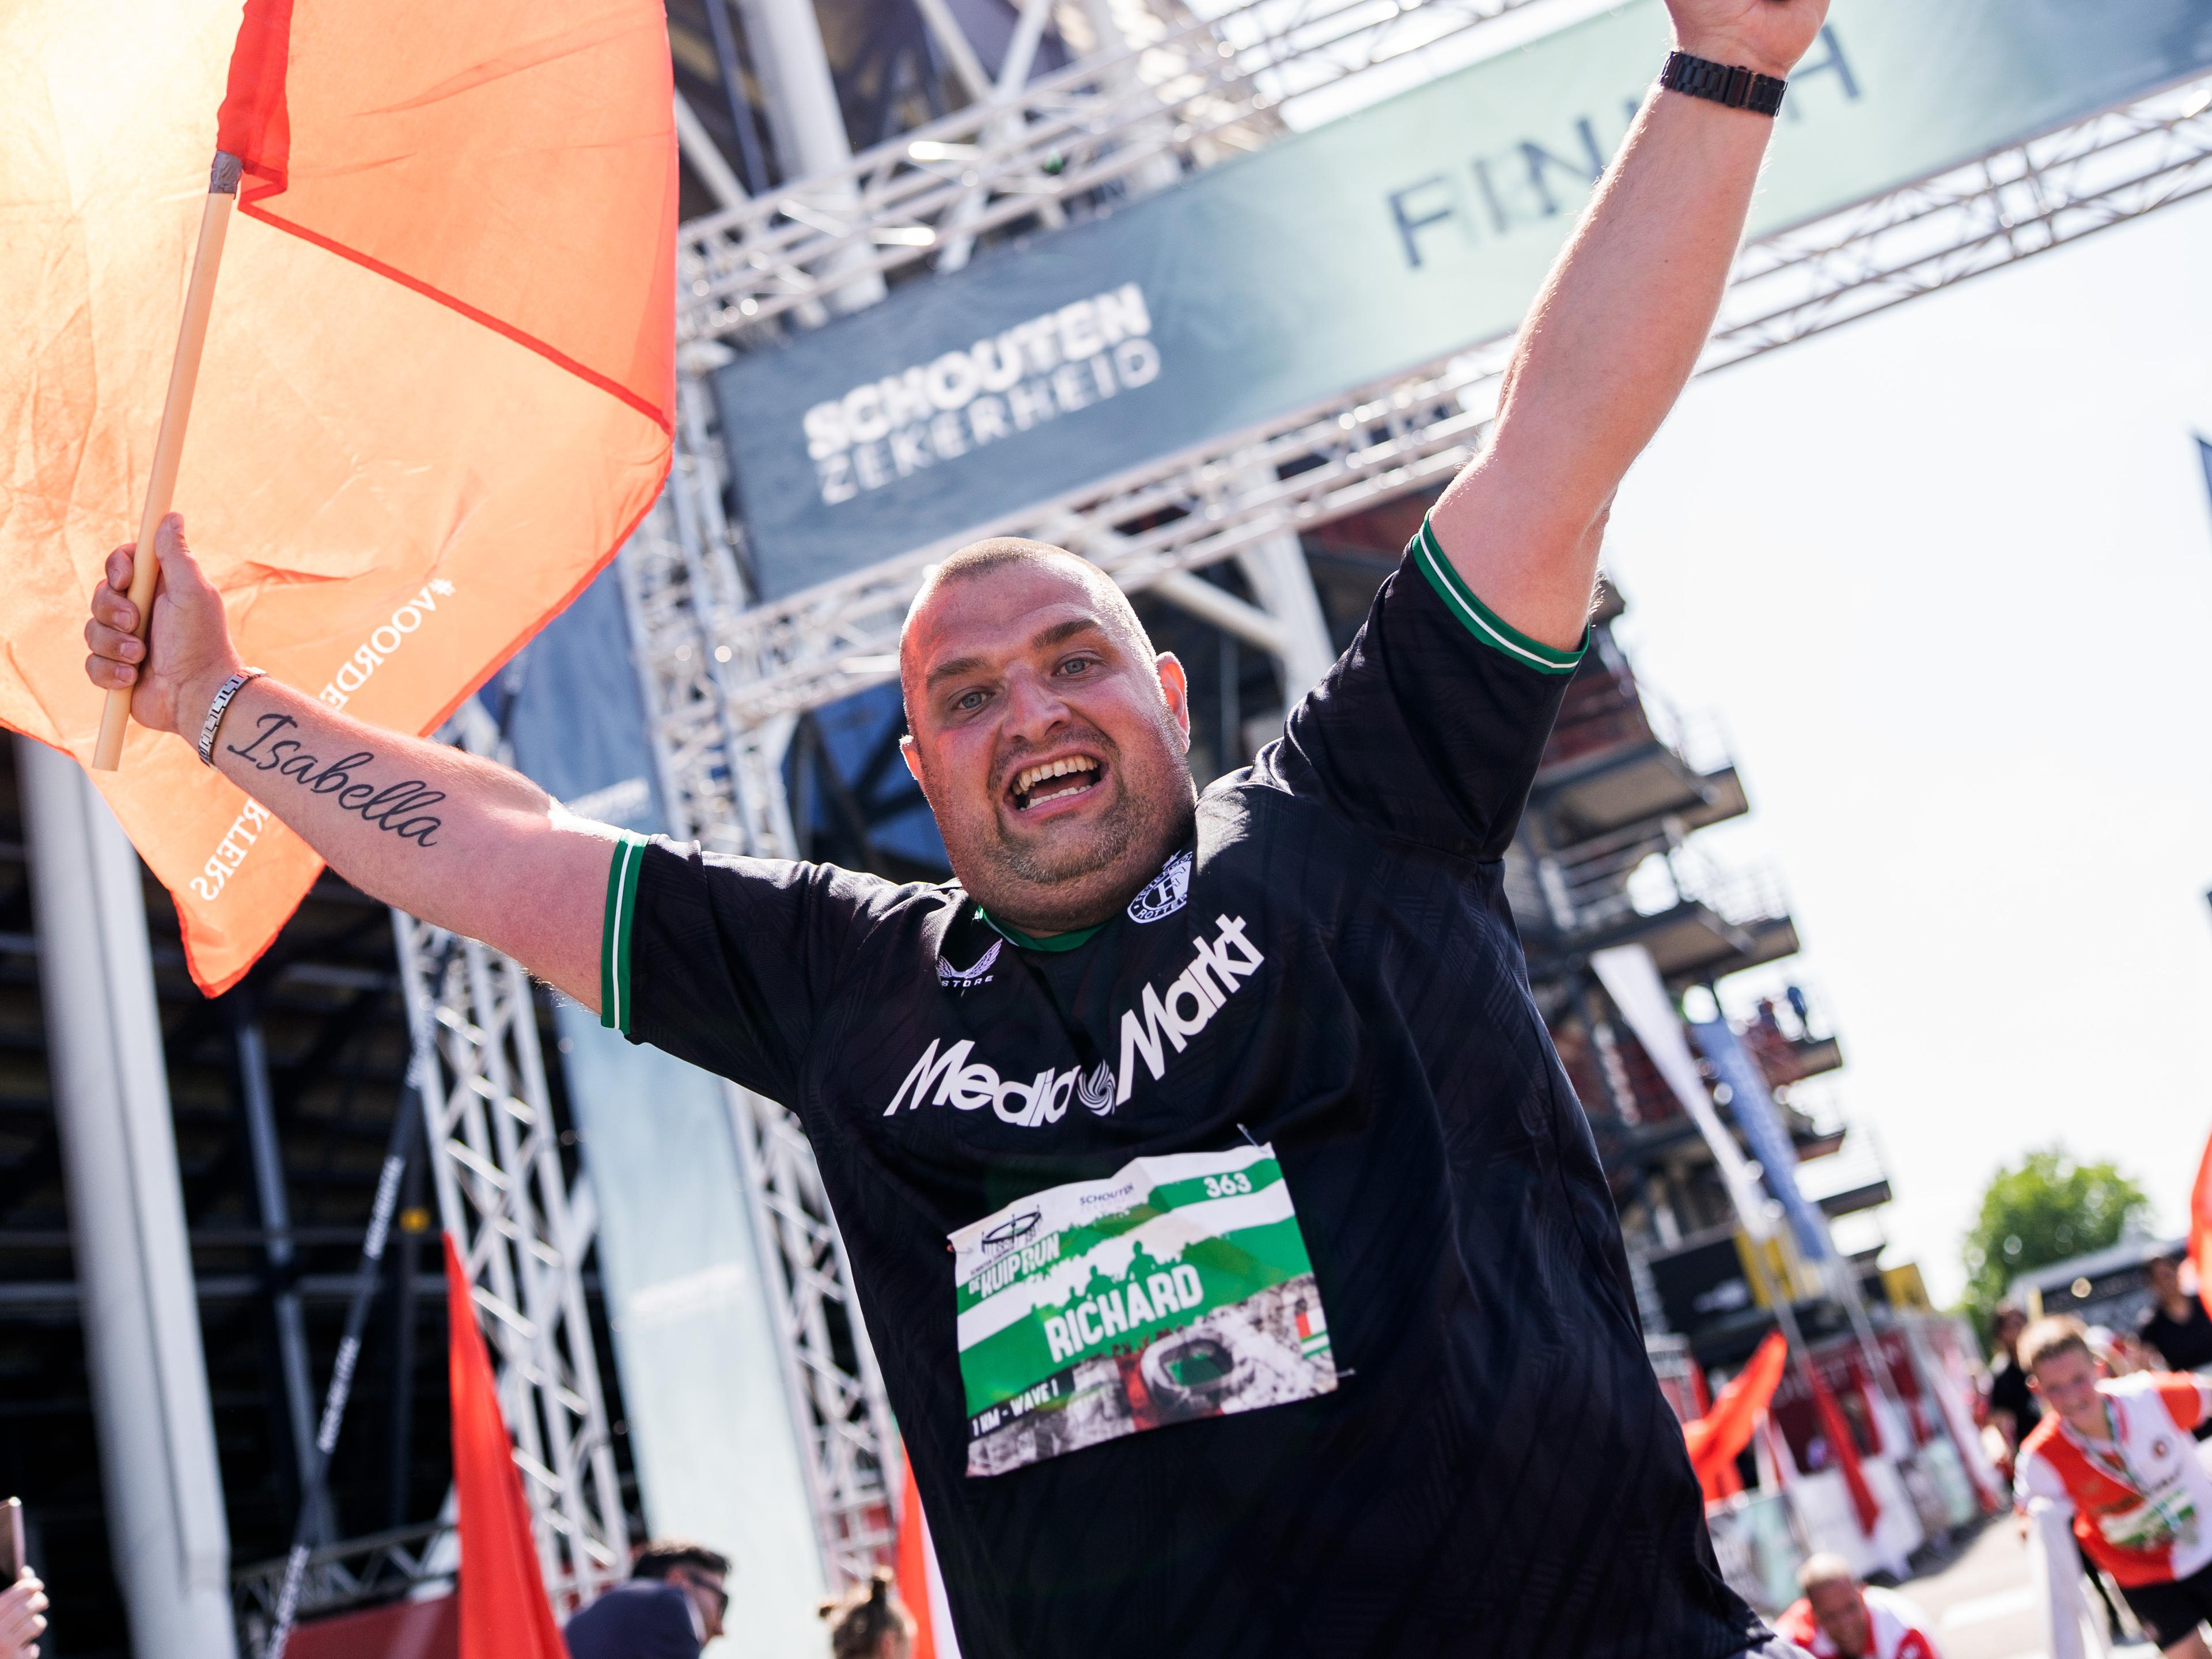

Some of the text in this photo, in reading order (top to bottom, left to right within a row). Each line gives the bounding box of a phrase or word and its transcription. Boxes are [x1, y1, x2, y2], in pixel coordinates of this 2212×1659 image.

[1385, 22, 1862, 268] FINH
[803, 281, 1152, 461] SCHOUTEN
[819, 338, 1161, 506] ZEKERHEID
[226, 713, 446, 847] Isabella
[941, 975, 994, 988] STORE
[1203, 1172, 1252, 1198] 363
[1043, 1263, 1204, 1364] RICHARD
[972, 1418, 980, 1437] 1
[979, 1407, 1001, 1434] KM
[1009, 1382, 1051, 1417] WAVE
[1050, 1377, 1059, 1397] 1
